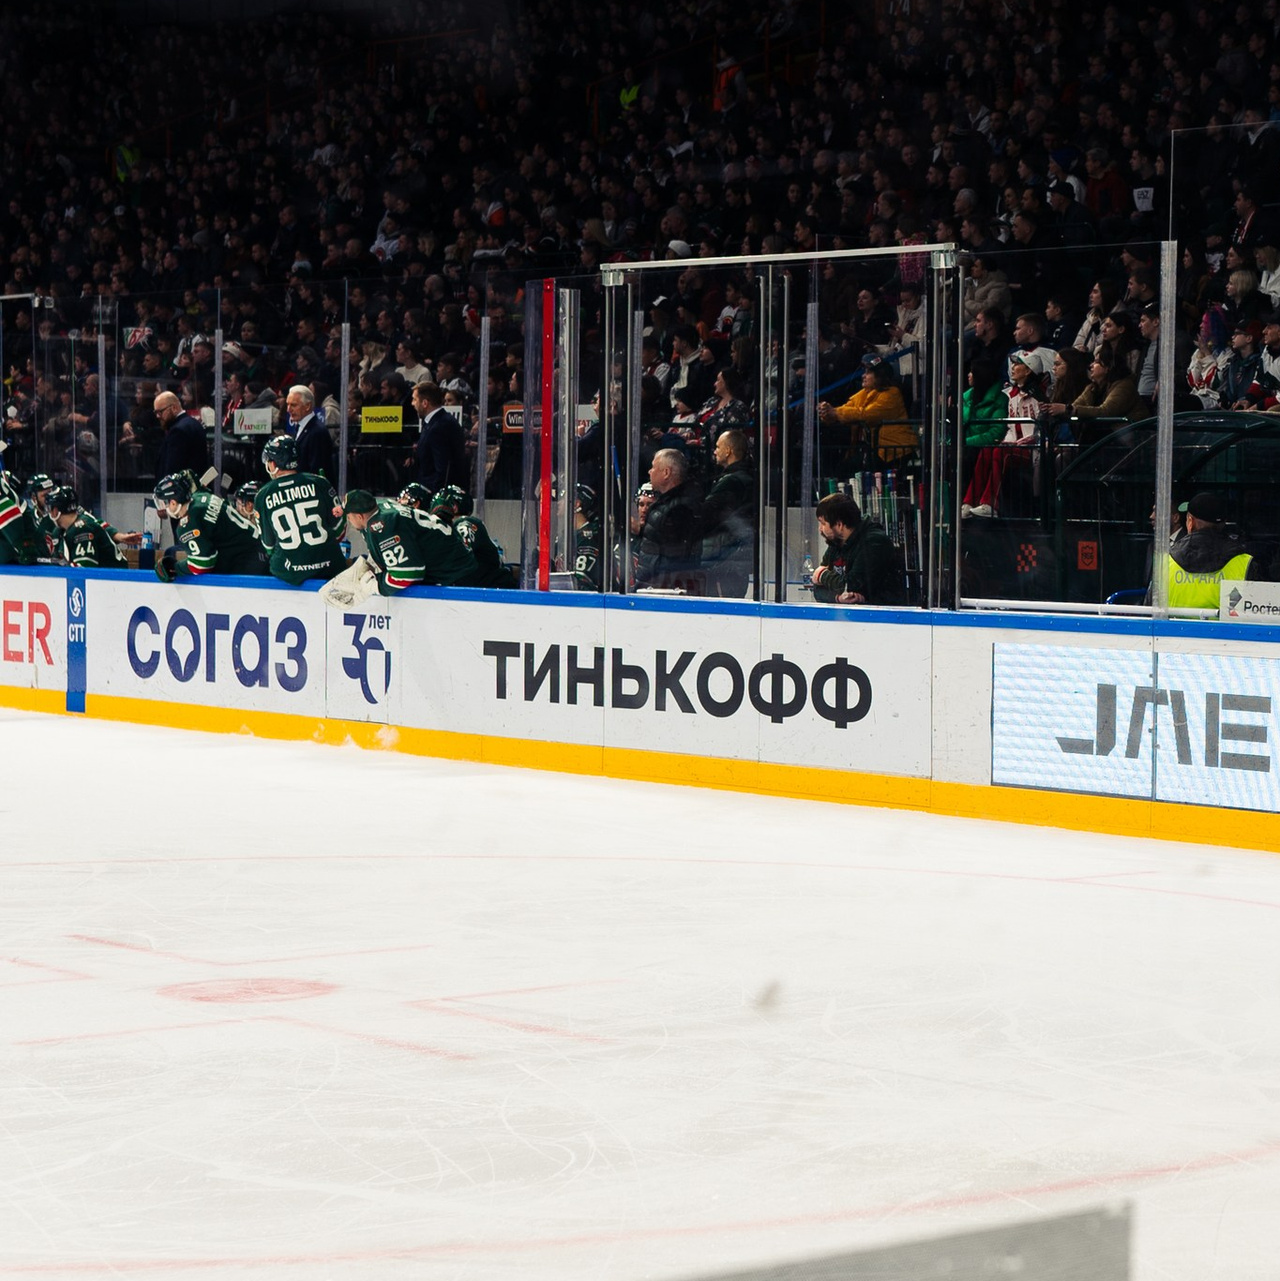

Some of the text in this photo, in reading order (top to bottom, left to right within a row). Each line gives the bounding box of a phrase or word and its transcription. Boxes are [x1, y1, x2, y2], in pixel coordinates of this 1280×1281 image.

[265, 483, 316, 510] GALIMOV
[271, 499, 328, 551] 95
[75, 541, 95, 557] 44
[187, 540, 201, 556] 9
[381, 545, 409, 567] 82
[292, 560, 331, 571] TATNEFT
[575, 555, 597, 571] 87
[368, 614, 391, 630] лет
[483, 640, 873, 729] ТИНЬКОФФ
